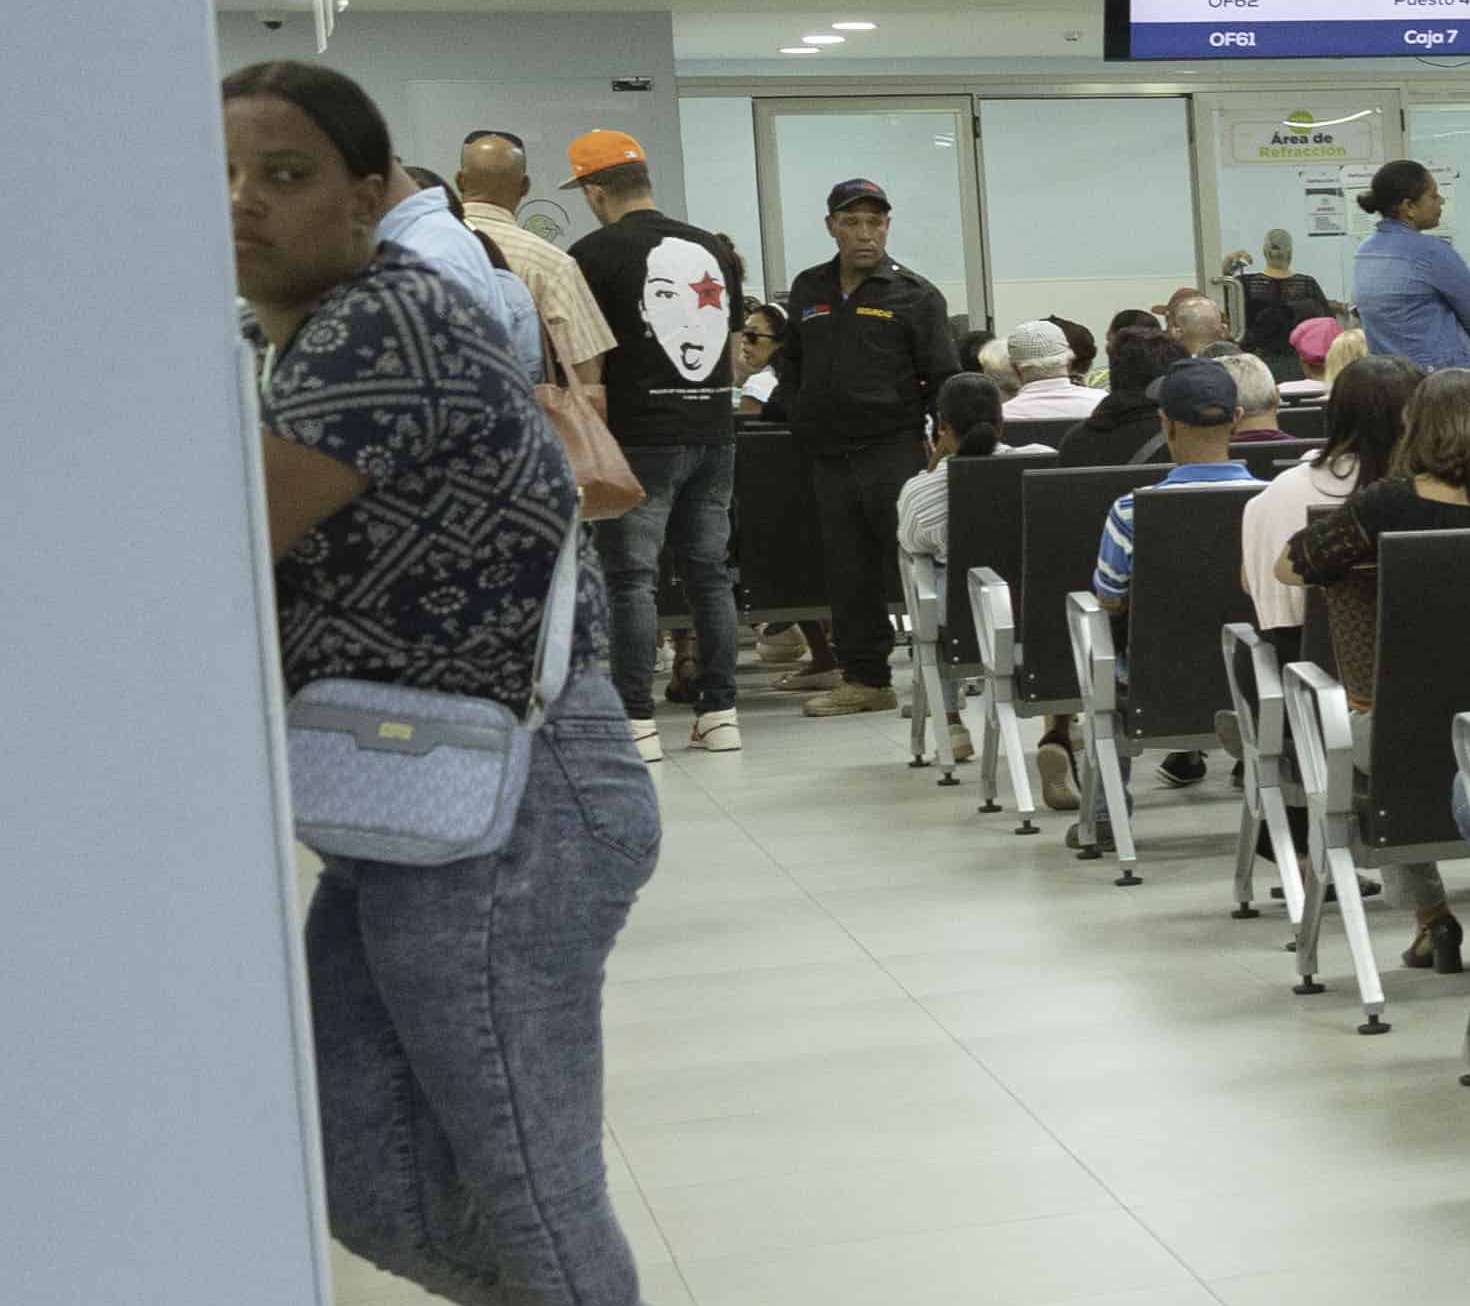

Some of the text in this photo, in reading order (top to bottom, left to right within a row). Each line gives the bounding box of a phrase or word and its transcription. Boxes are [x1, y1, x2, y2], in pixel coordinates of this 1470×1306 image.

[1209, 31, 1257, 47] OF61
[1403, 29, 1459, 49] Caja 7
[1271, 131, 1334, 145] Área de
